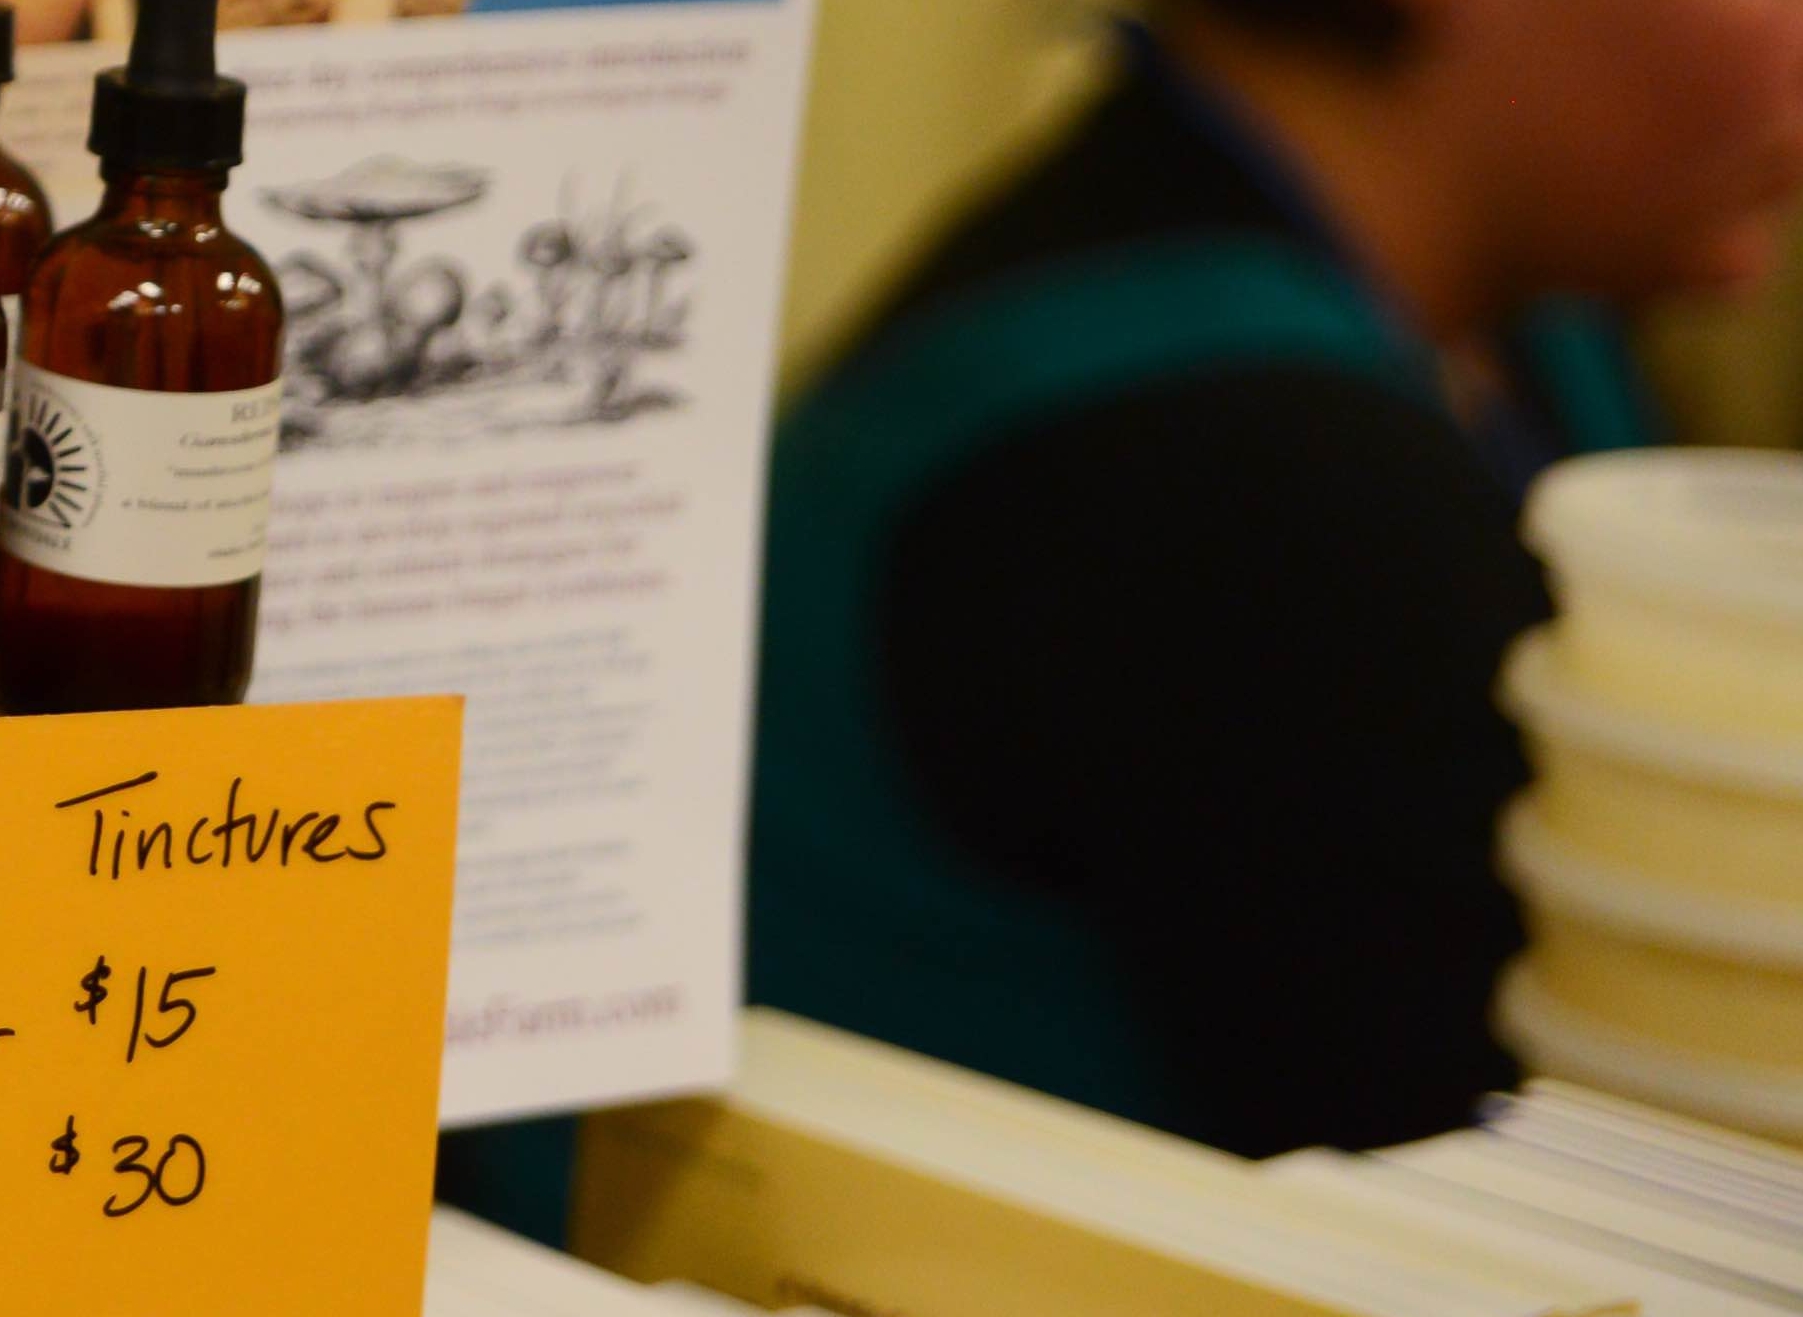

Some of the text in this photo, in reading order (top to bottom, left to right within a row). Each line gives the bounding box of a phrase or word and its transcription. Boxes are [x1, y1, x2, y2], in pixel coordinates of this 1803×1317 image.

[55, 770, 398, 880] Tinctures
[73, 955, 218, 1064] $15
[48, 1114, 207, 1219] $30
